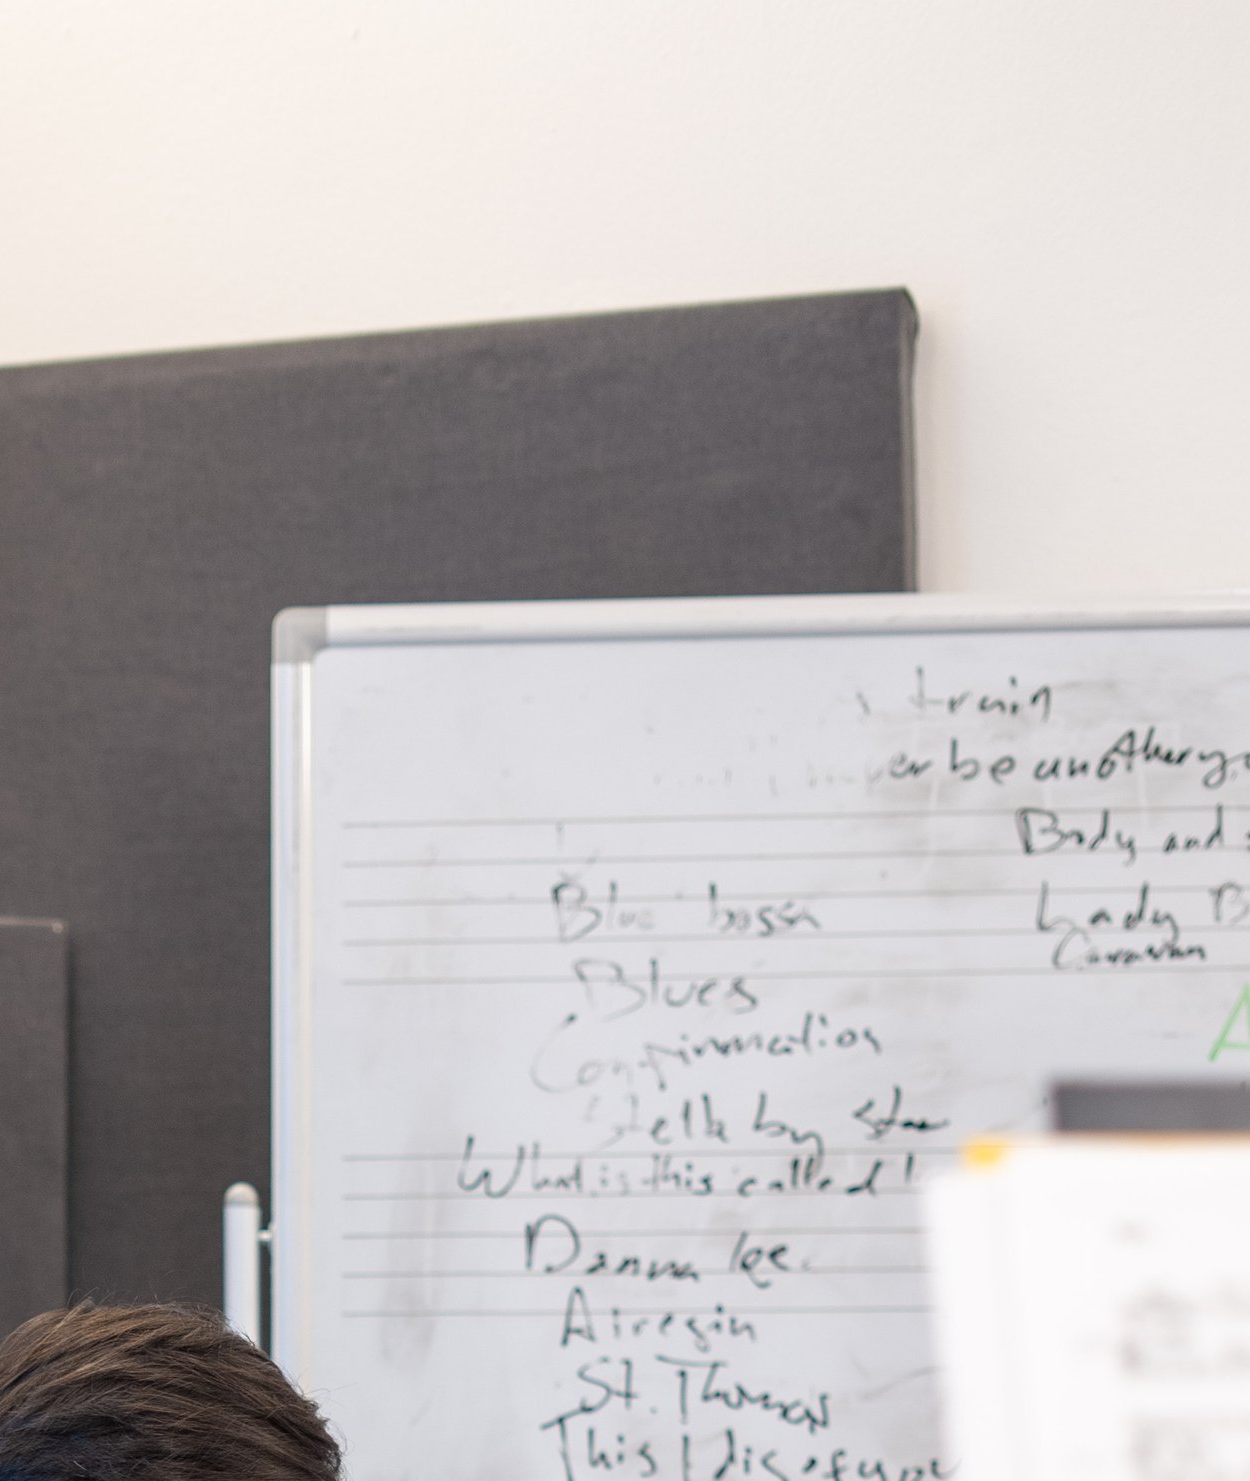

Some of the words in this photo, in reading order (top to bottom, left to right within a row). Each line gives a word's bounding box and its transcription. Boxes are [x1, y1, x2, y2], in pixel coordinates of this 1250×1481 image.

[948, 736, 1018, 785] be
[1014, 806, 1138, 867] Body
[1162, 803, 1225, 853] and
[1036, 880, 1181, 946] Lady
[570, 956, 760, 1022] Blues
[752, 1090, 827, 1168] by
